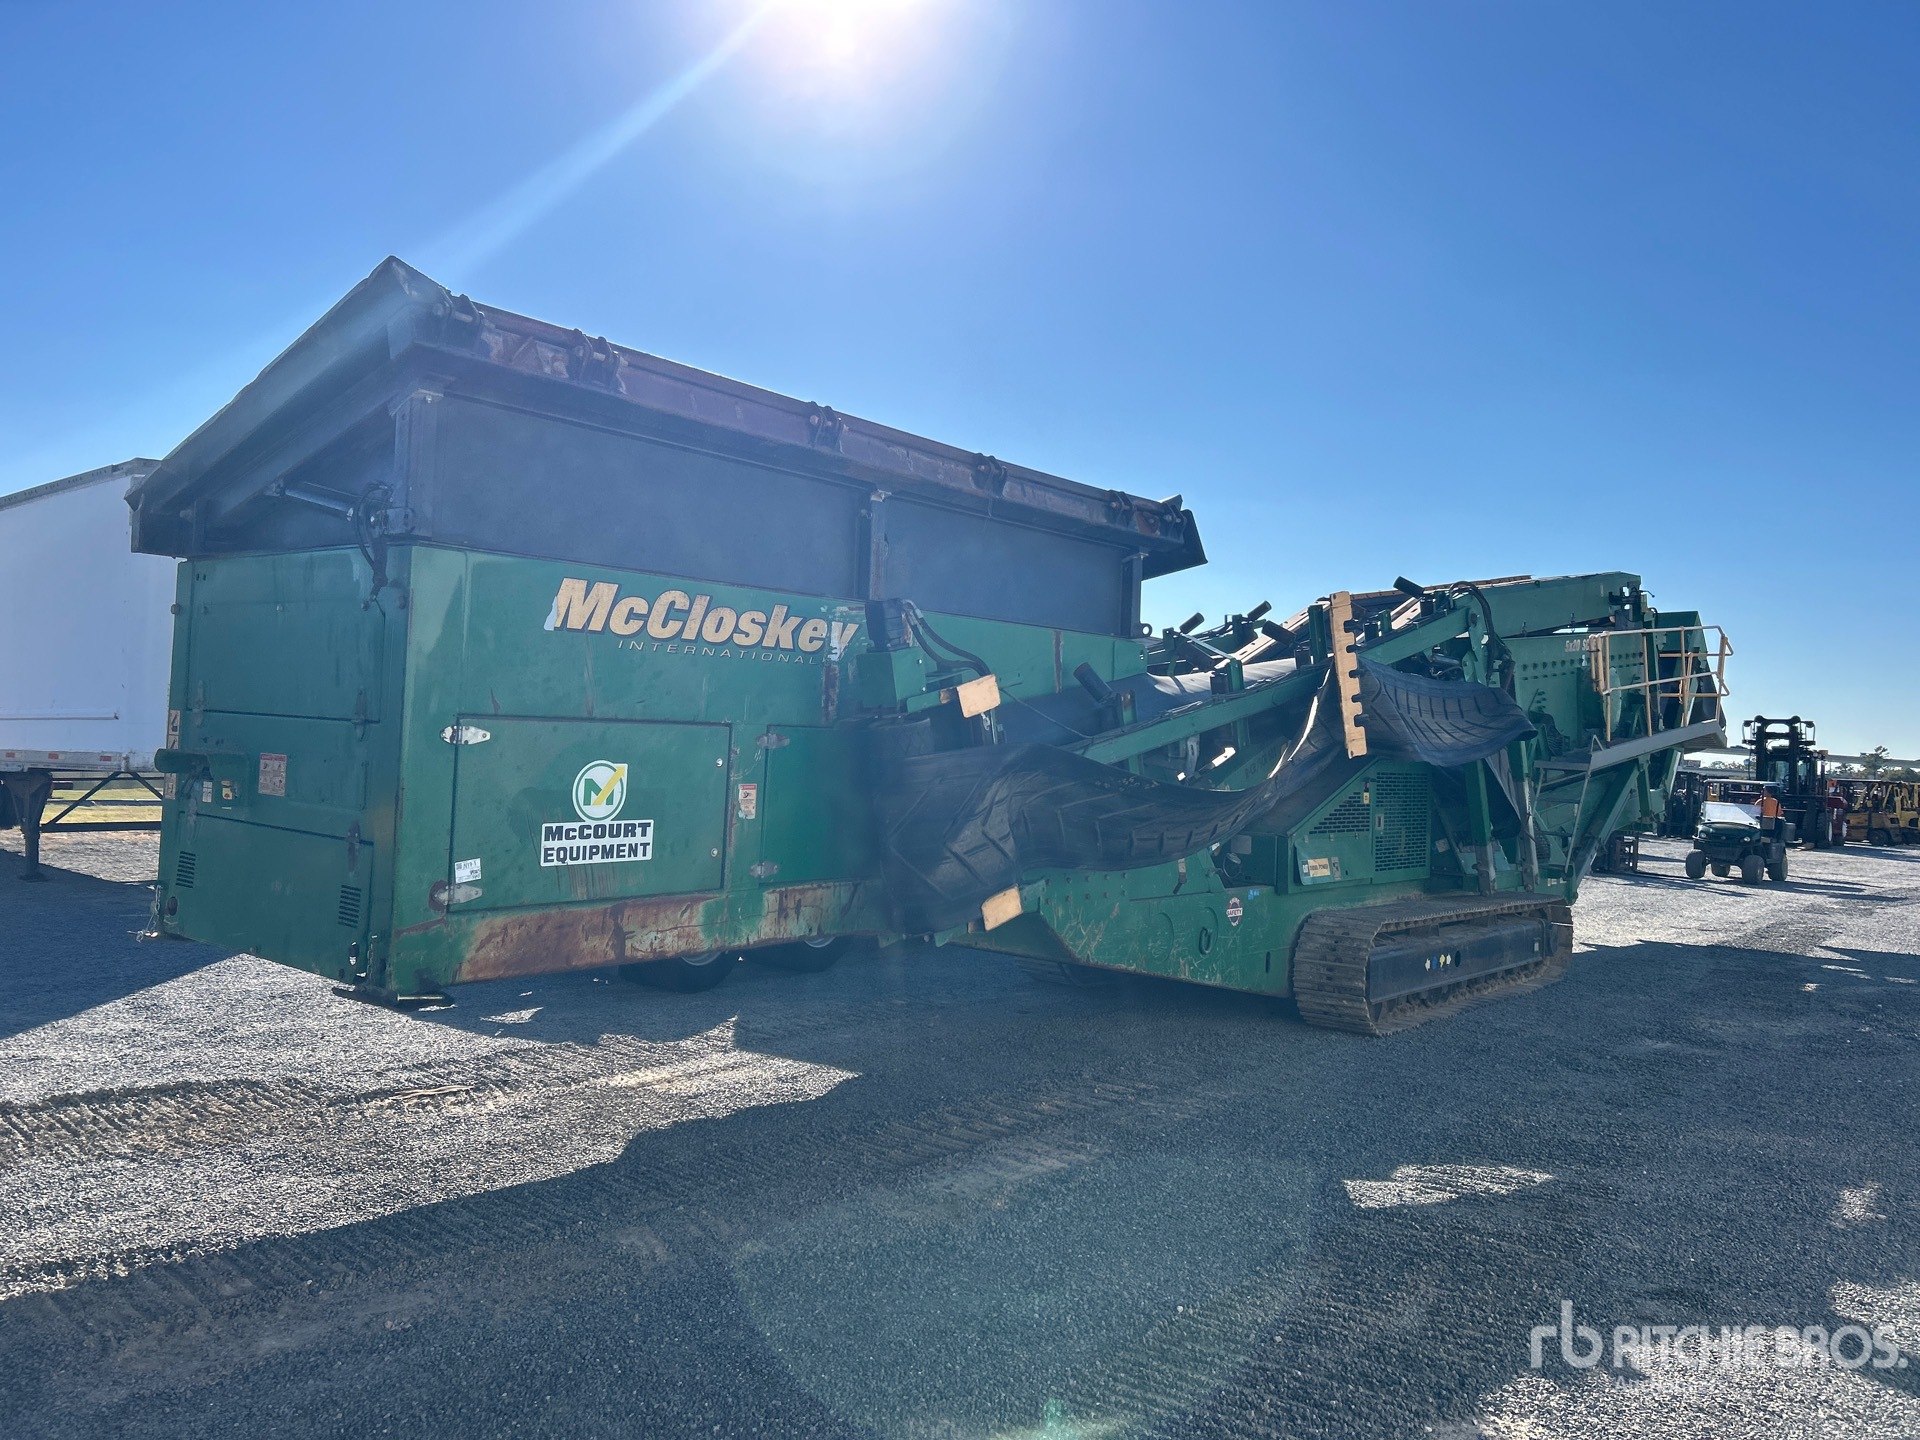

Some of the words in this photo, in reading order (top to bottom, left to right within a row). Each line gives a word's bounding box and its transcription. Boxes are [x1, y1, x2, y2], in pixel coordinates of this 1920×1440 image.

[545, 576, 859, 655] McCloskey
[617, 638, 819, 666] INTERNATIONAL
[542, 842, 651, 864] EQUIPMENT
